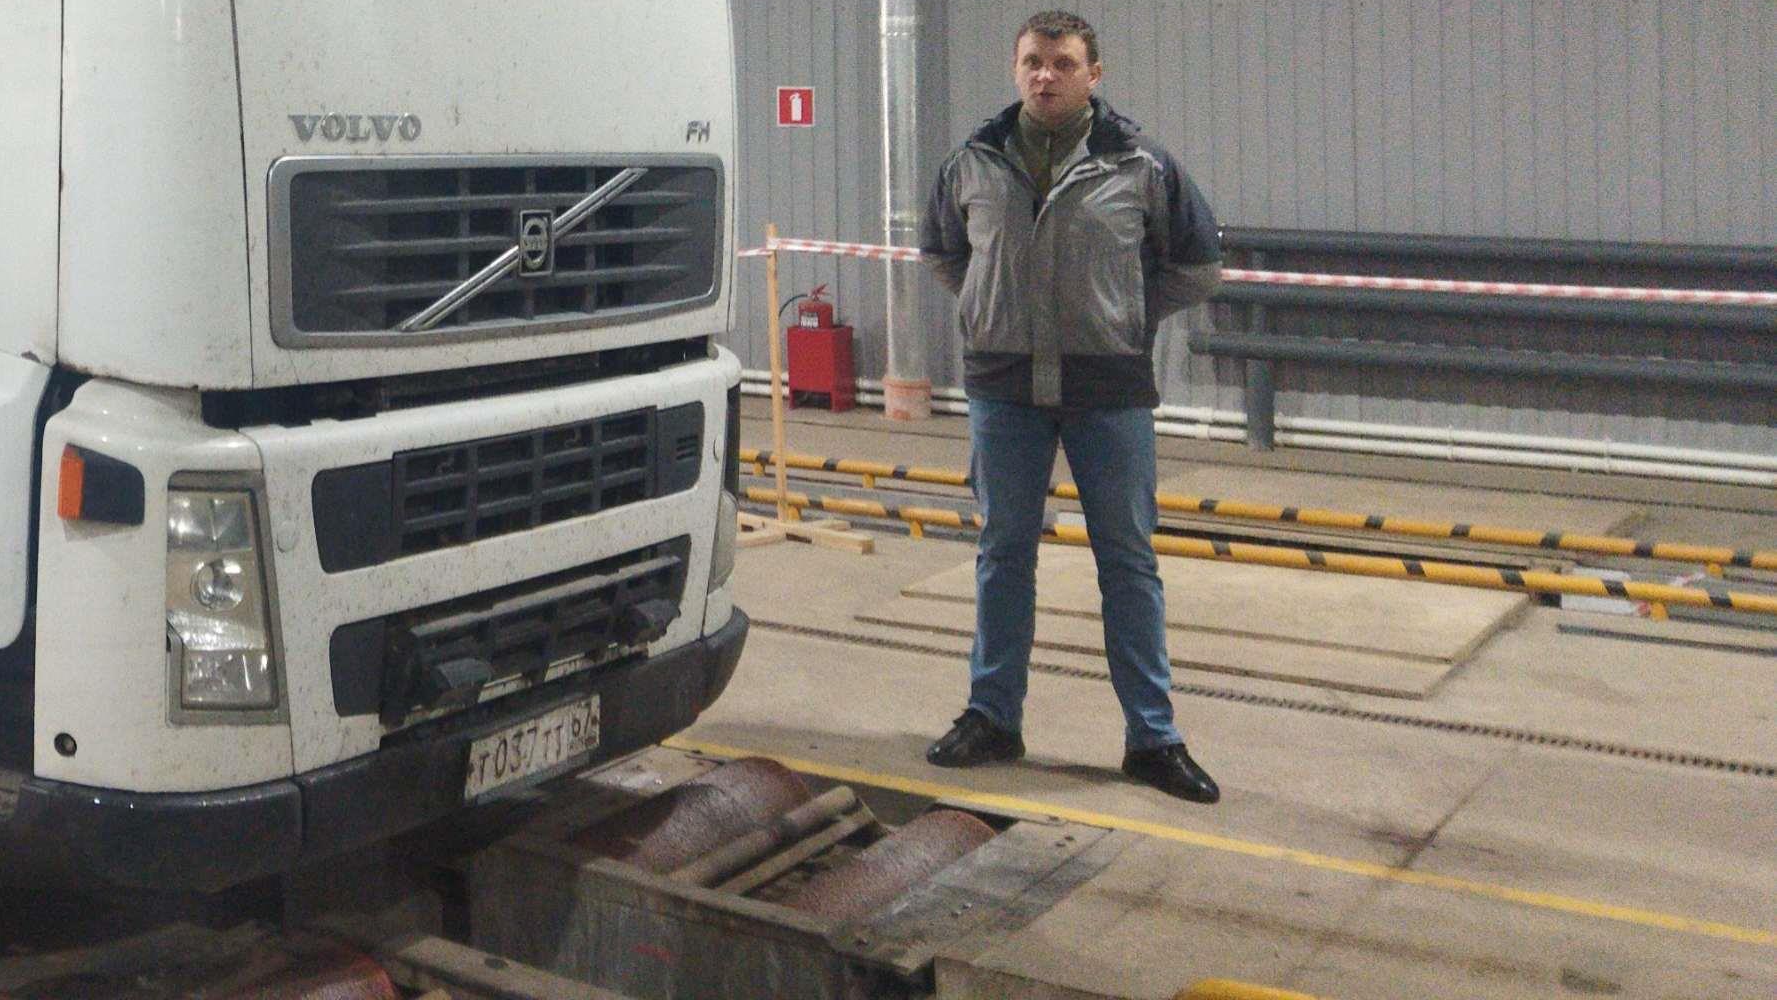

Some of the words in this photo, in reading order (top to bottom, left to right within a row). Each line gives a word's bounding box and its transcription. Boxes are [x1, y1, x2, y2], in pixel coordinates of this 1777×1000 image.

[288, 111, 422, 143] VOLVO
[685, 119, 711, 144] FH
[478, 723, 564, 785] T037TT
